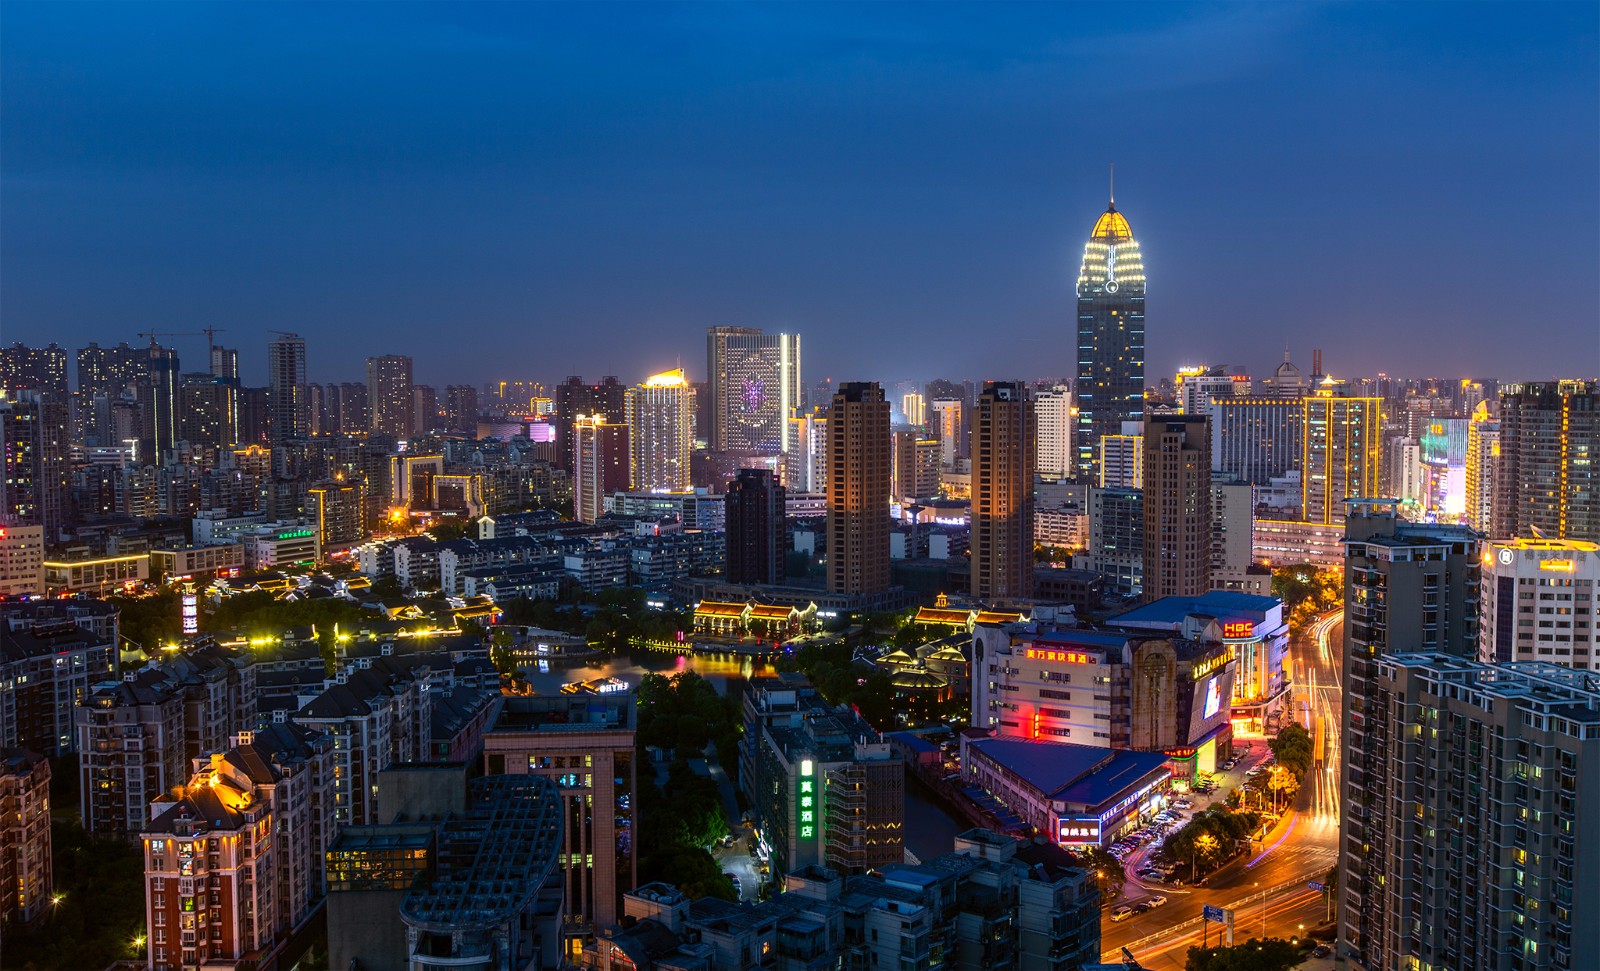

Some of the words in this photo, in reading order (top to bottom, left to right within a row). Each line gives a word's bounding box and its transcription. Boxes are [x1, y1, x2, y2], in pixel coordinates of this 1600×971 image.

[1224, 623, 1252, 631] HBC
[801, 781, 813, 837] 莫泰酒店
